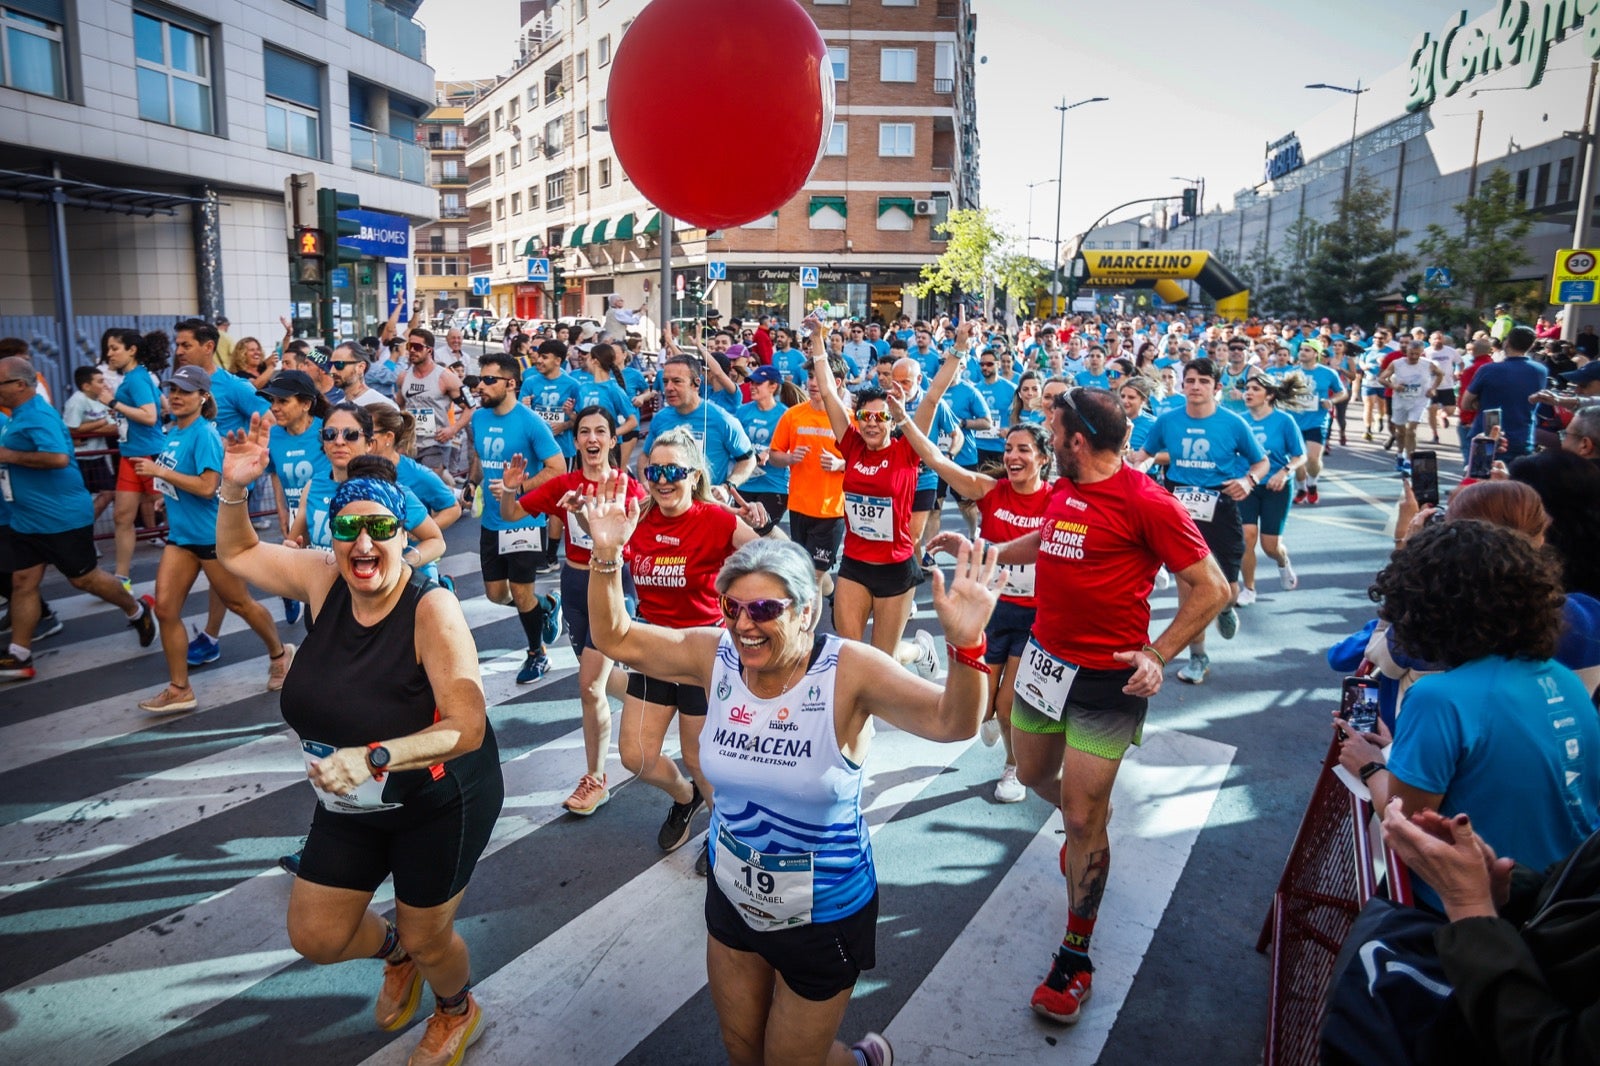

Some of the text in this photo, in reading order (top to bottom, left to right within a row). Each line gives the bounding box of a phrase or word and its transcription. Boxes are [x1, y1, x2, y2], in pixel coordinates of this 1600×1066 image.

[347, 226, 406, 245] BAHOMES
[1098, 255, 1192, 269] MARCELINO
[1570, 258, 1590, 268] 30
[483, 436, 504, 460] 18
[1181, 438, 1210, 460] 18
[1179, 493, 1210, 502] 1383
[852, 503, 885, 519] 1387
[1055, 520, 1088, 535] MEMORIAL
[1052, 530, 1085, 547] PADRE
[655, 556, 687, 565] MEMORIAL
[652, 565, 685, 576] PADRE
[633, 575, 687, 587] MARCELINO
[1030, 649, 1065, 683] 1384
[769, 720, 799, 732] mayfo
[713, 727, 812, 758] MARACENA
[718, 749, 797, 767] CLUB DE ATLETISMO
[741, 865, 775, 895] 19
[755, 893, 785, 904] ISABEL
